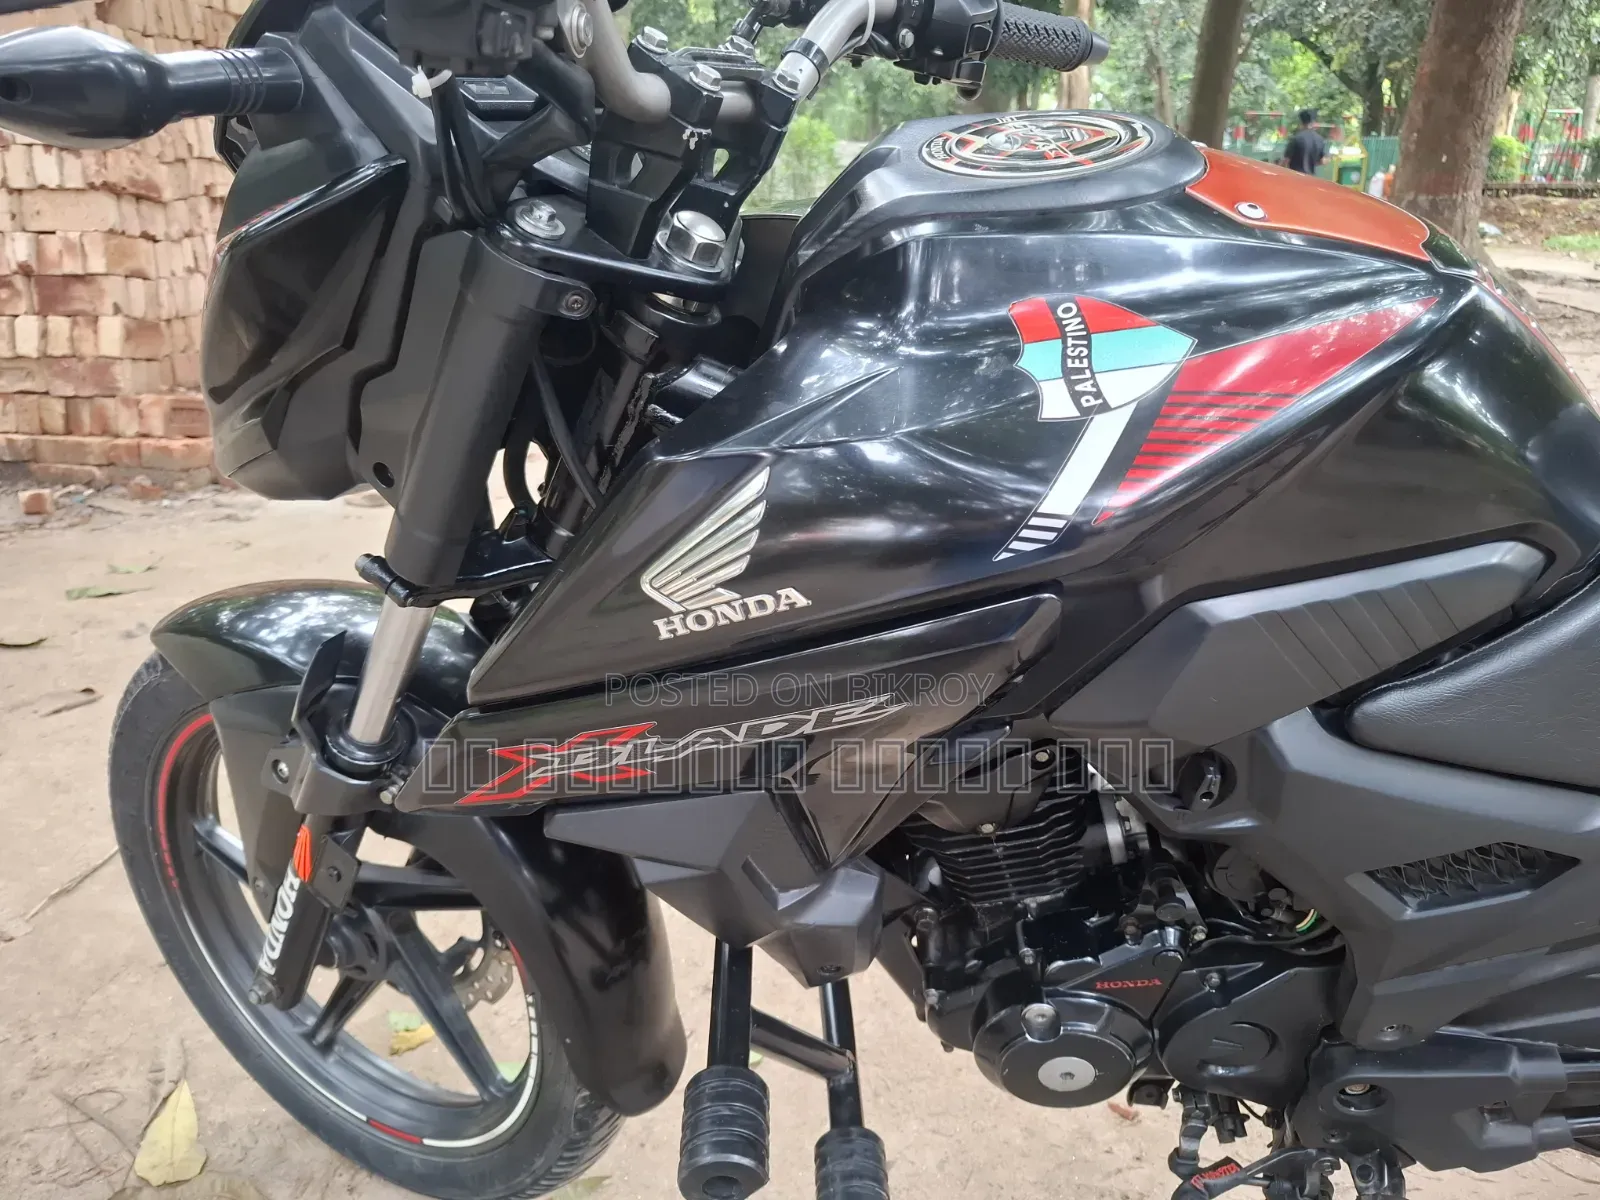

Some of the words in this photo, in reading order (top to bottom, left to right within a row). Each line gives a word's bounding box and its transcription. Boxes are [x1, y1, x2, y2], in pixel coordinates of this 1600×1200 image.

[1057, 302, 1103, 408] PALESTINO
[652, 587, 813, 640] HONDA
[1095, 977, 1163, 989] HONDA
